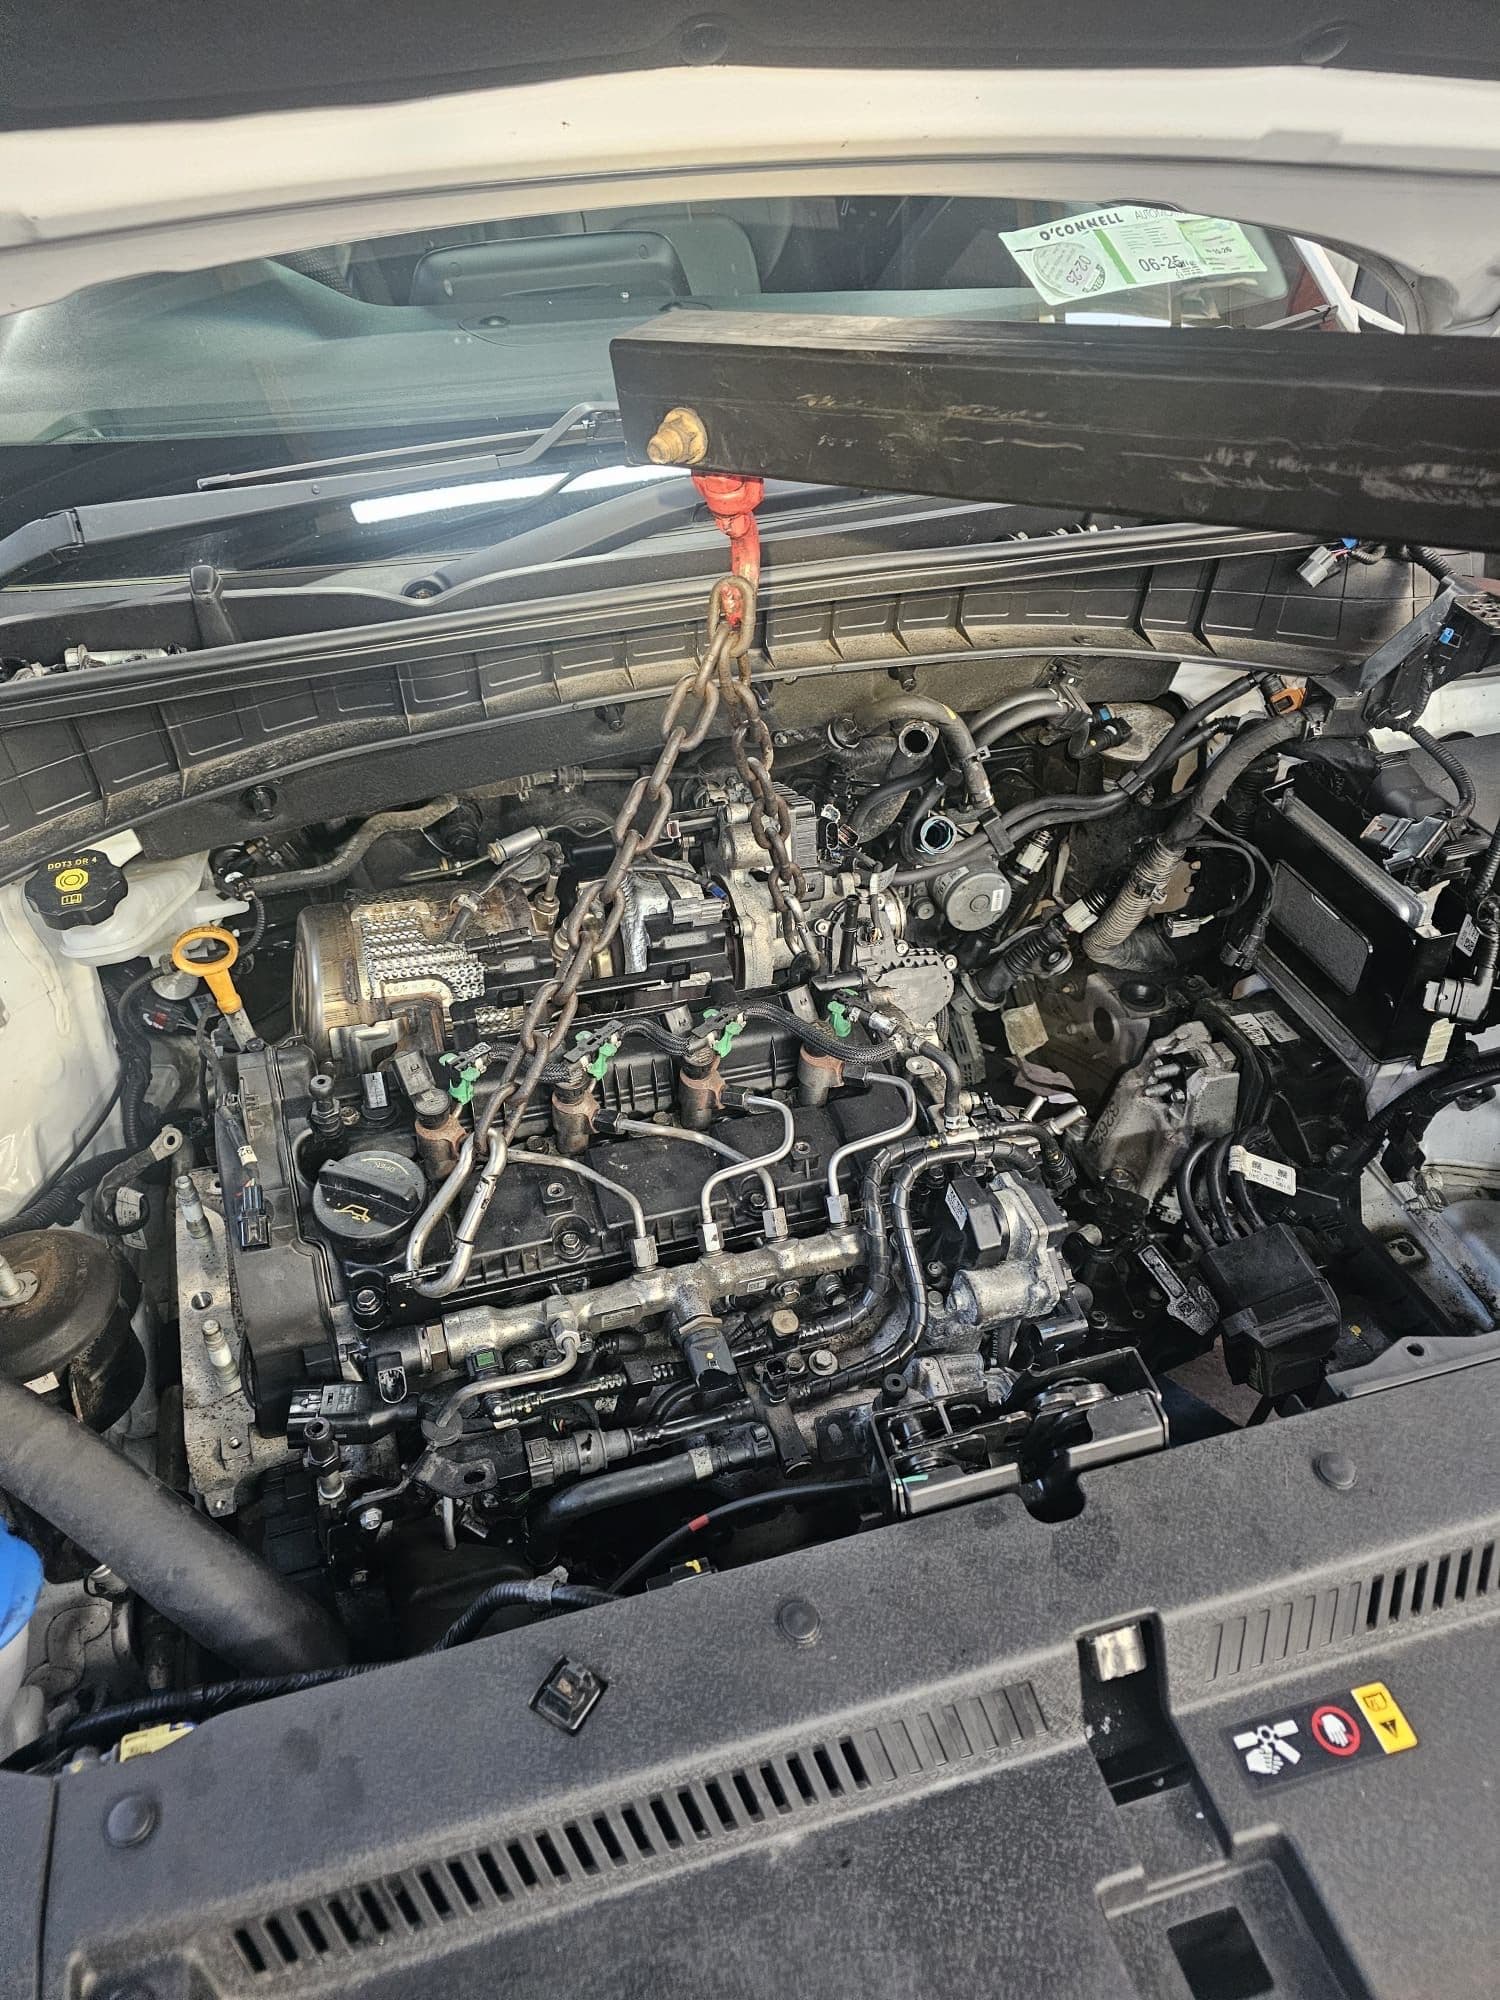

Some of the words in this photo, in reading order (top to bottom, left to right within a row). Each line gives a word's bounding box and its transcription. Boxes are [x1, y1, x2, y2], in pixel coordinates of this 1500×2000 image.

[1040, 213, 1124, 241] O'CONNELL
[1138, 255, 1180, 272] 06-25
[47, 861, 73, 870] DOT3
[74, 858, 89, 866] OR
